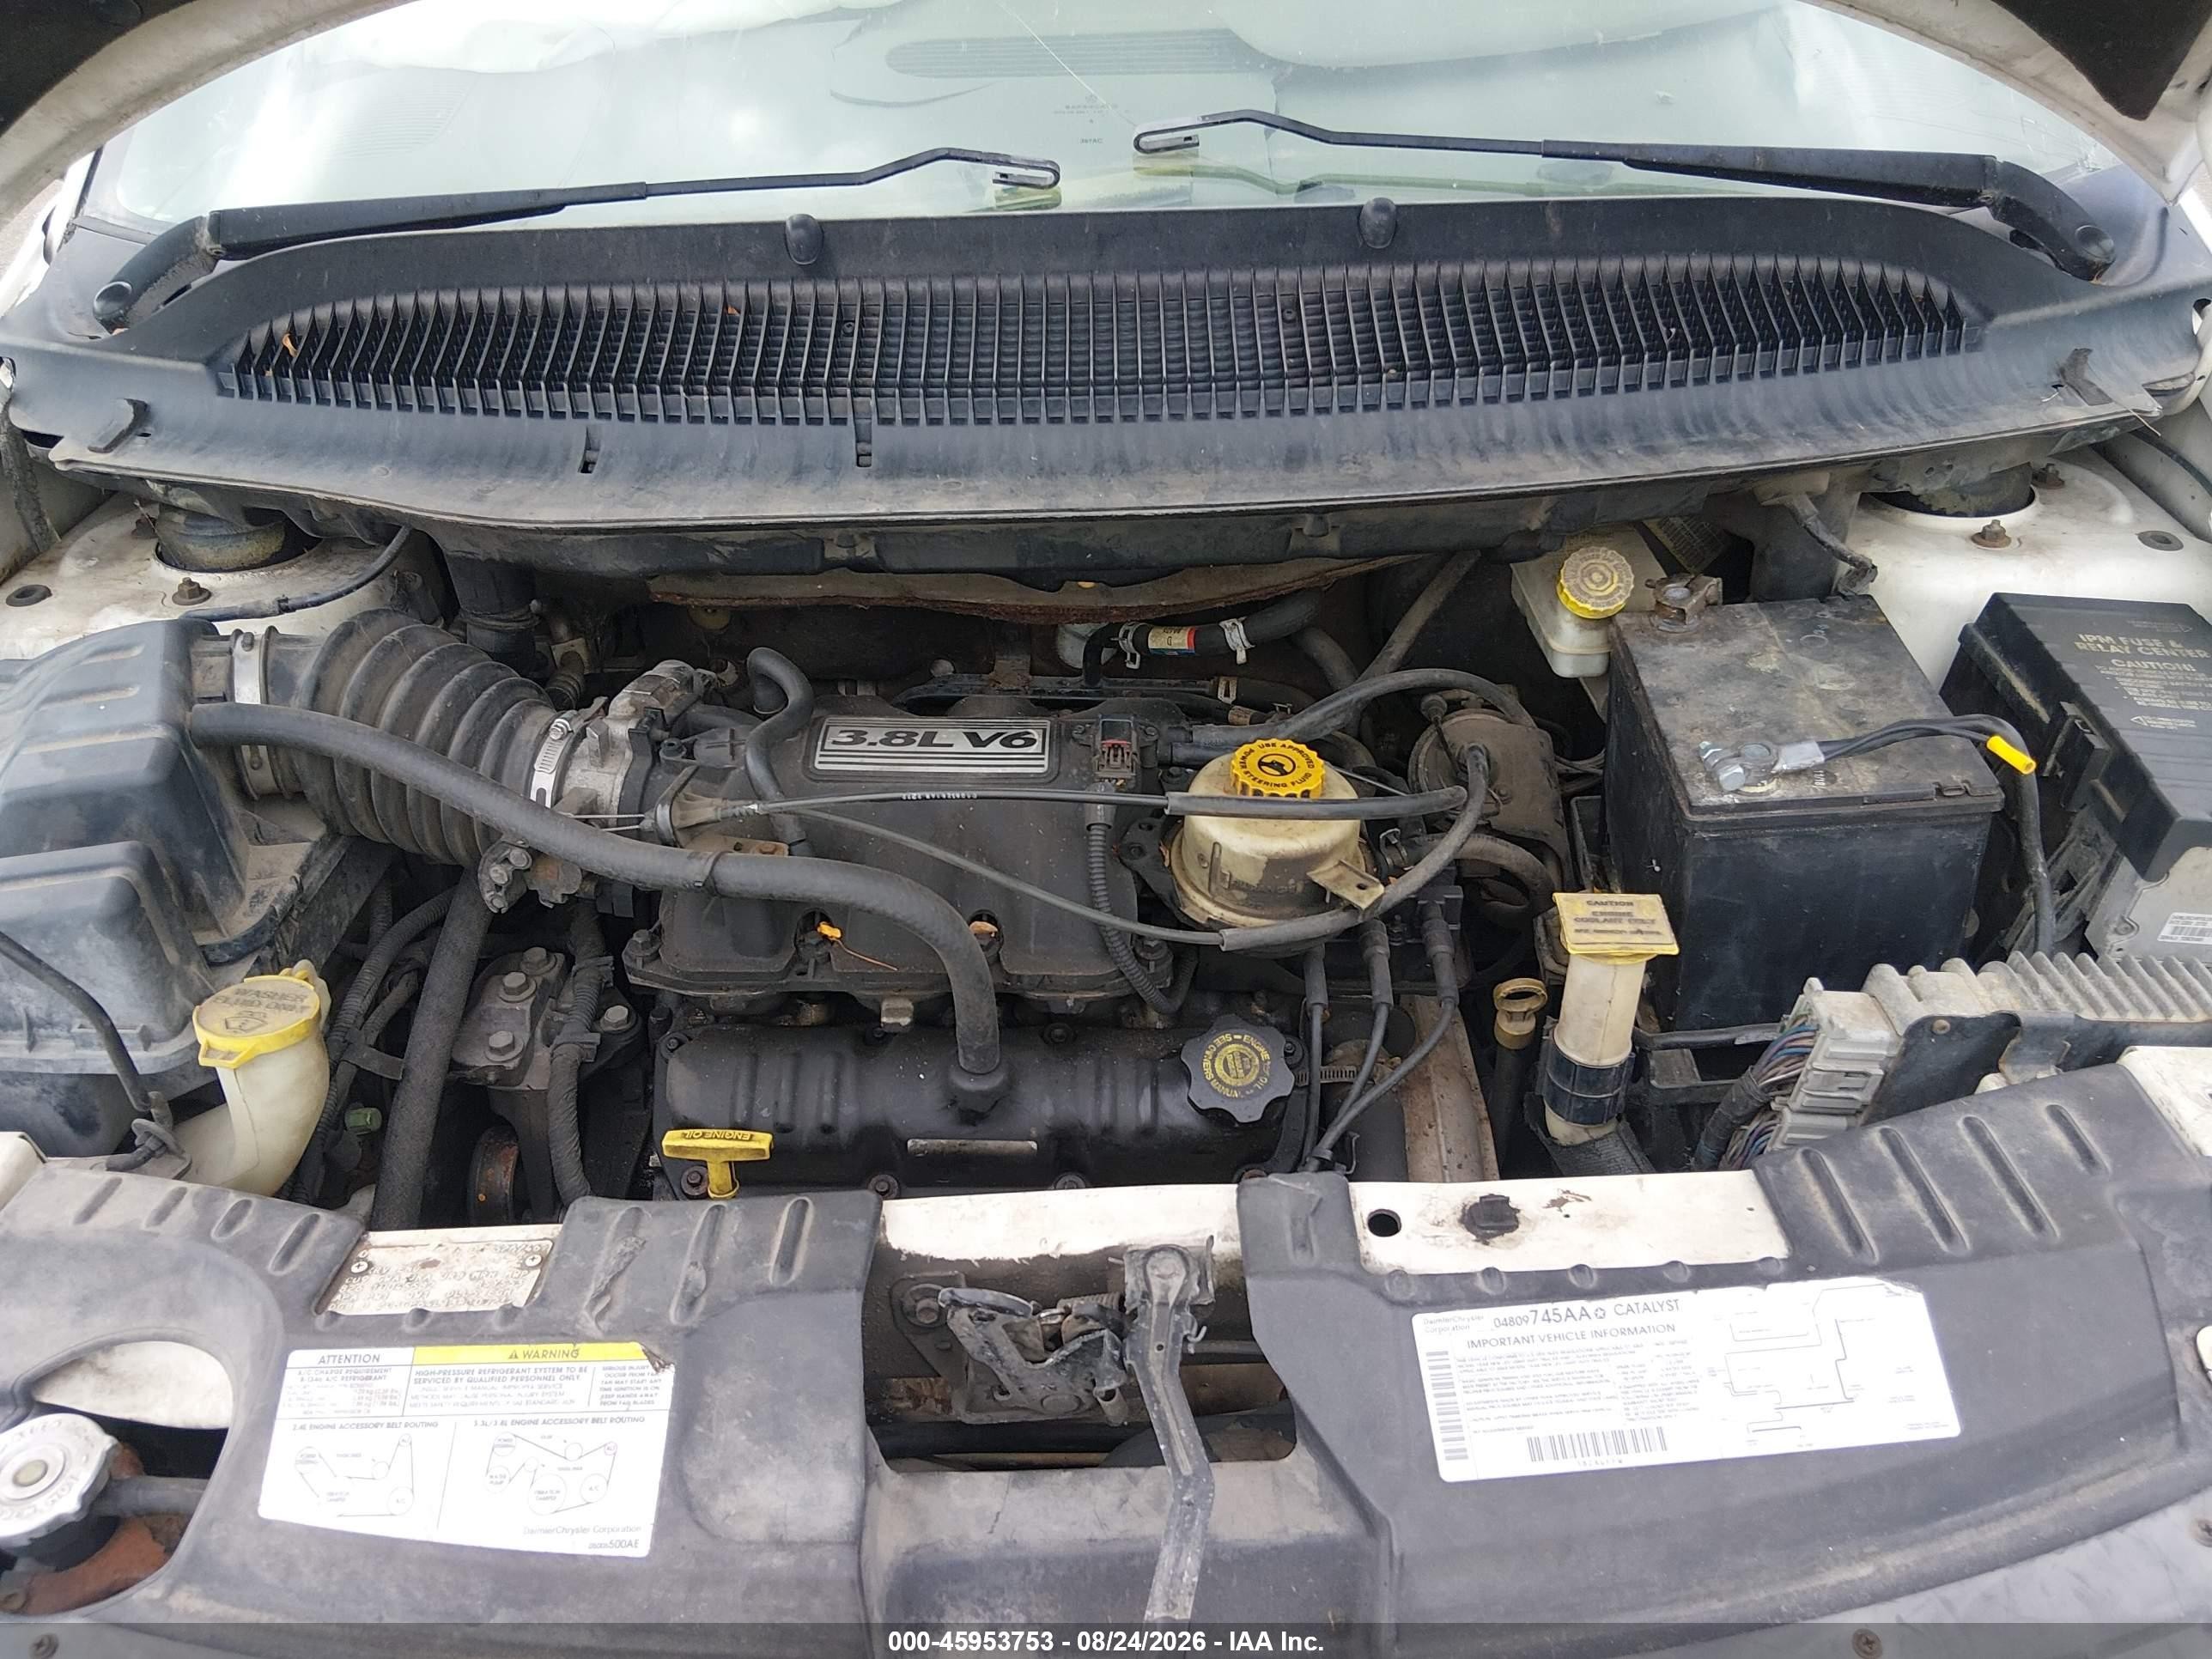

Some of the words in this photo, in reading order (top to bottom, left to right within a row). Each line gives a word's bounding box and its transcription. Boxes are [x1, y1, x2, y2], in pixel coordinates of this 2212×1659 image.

[2077, 634, 2115, 644] IPM
[2118, 636, 2164, 647] FUSE
[2074, 641, 2130, 654] RELAY
[2136, 647, 2212, 659] CENTER
[830, 730, 954, 748] 3.8L
[963, 730, 1037, 749] V6
[1280, 743, 1316, 769] APPROVED
[1244, 771, 1288, 787] STEERING
[1291, 772, 1313, 787] FLUID
[234, 988, 308, 1003] WASHER
[1213, 1033, 1233, 1048] SEE
[1243, 1034, 1271, 1061] ENGINE
[1253, 1078, 1268, 1090] OIL
[685, 1130, 703, 1139] OIL
[704, 1131, 751, 1140] ENGINE
[1493, 1306, 1592, 1329] 04809745AA
[1613, 1299, 1680, 1316] CATALYST
[1425, 1324, 1470, 1333] Corporation
[1467, 1334, 1534, 1349] IMPORTANT
[1538, 1331, 1587, 1344] VEHICLE
[1590, 1324, 1676, 1339] INFORMATION
[318, 1353, 380, 1364] ATTENTION
[522, 1349, 580, 1359] WARNING
[510, 1418, 539, 1426] ENGINE
[542, 1417, 589, 1425] ACCESSORY
[523, 1526, 590, 1535] DaimlerChrysler
[592, 1525, 641, 1534] Corporation
